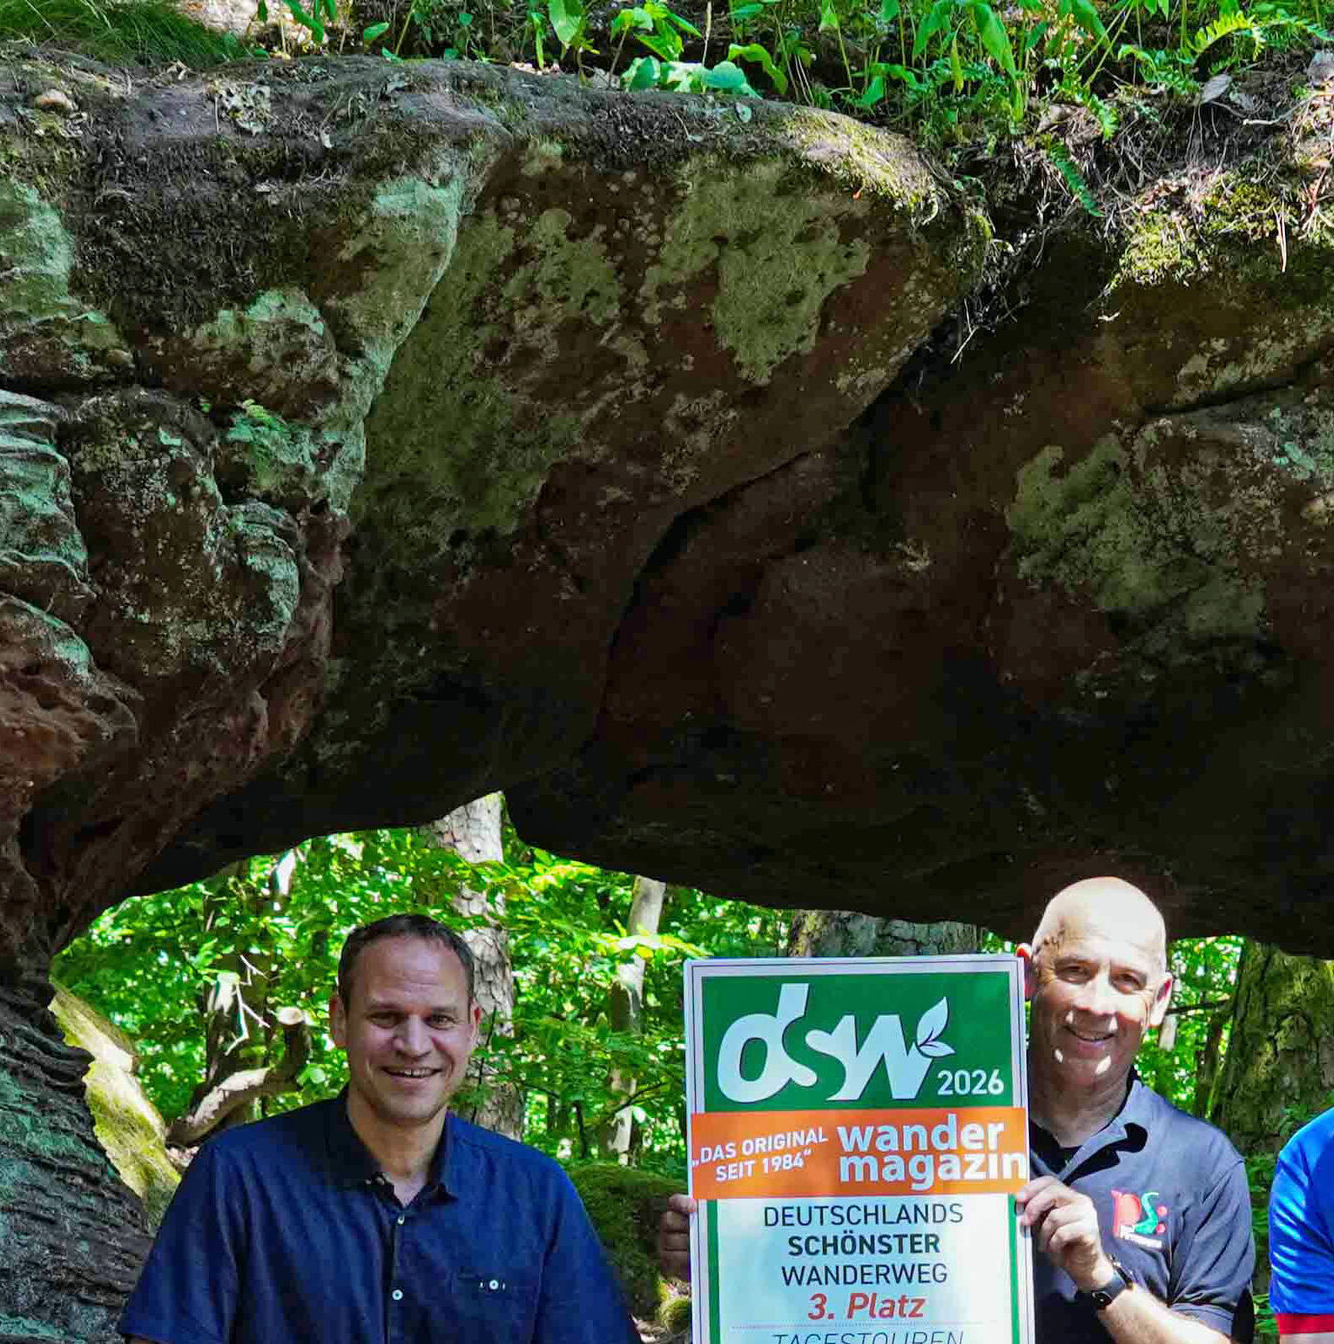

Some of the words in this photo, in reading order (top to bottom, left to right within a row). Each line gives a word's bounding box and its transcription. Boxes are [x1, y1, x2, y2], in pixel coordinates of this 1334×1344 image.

[717, 983, 937, 1103] dsw
[937, 1070, 1004, 1096] 2026
[741, 1127, 829, 1156] ORIGINAL
[836, 1113, 1004, 1152] wander
[716, 1160, 756, 1182] SEIT
[840, 1152, 1027, 1190] magazin
[764, 1203, 964, 1228] DEUTSCHLANDS
[787, 1230, 941, 1257] SCHÖNSTER
[781, 1263, 949, 1287] WANDERWEG
[807, 1294, 836, 1320] 3.
[846, 1292, 927, 1320] Platz
